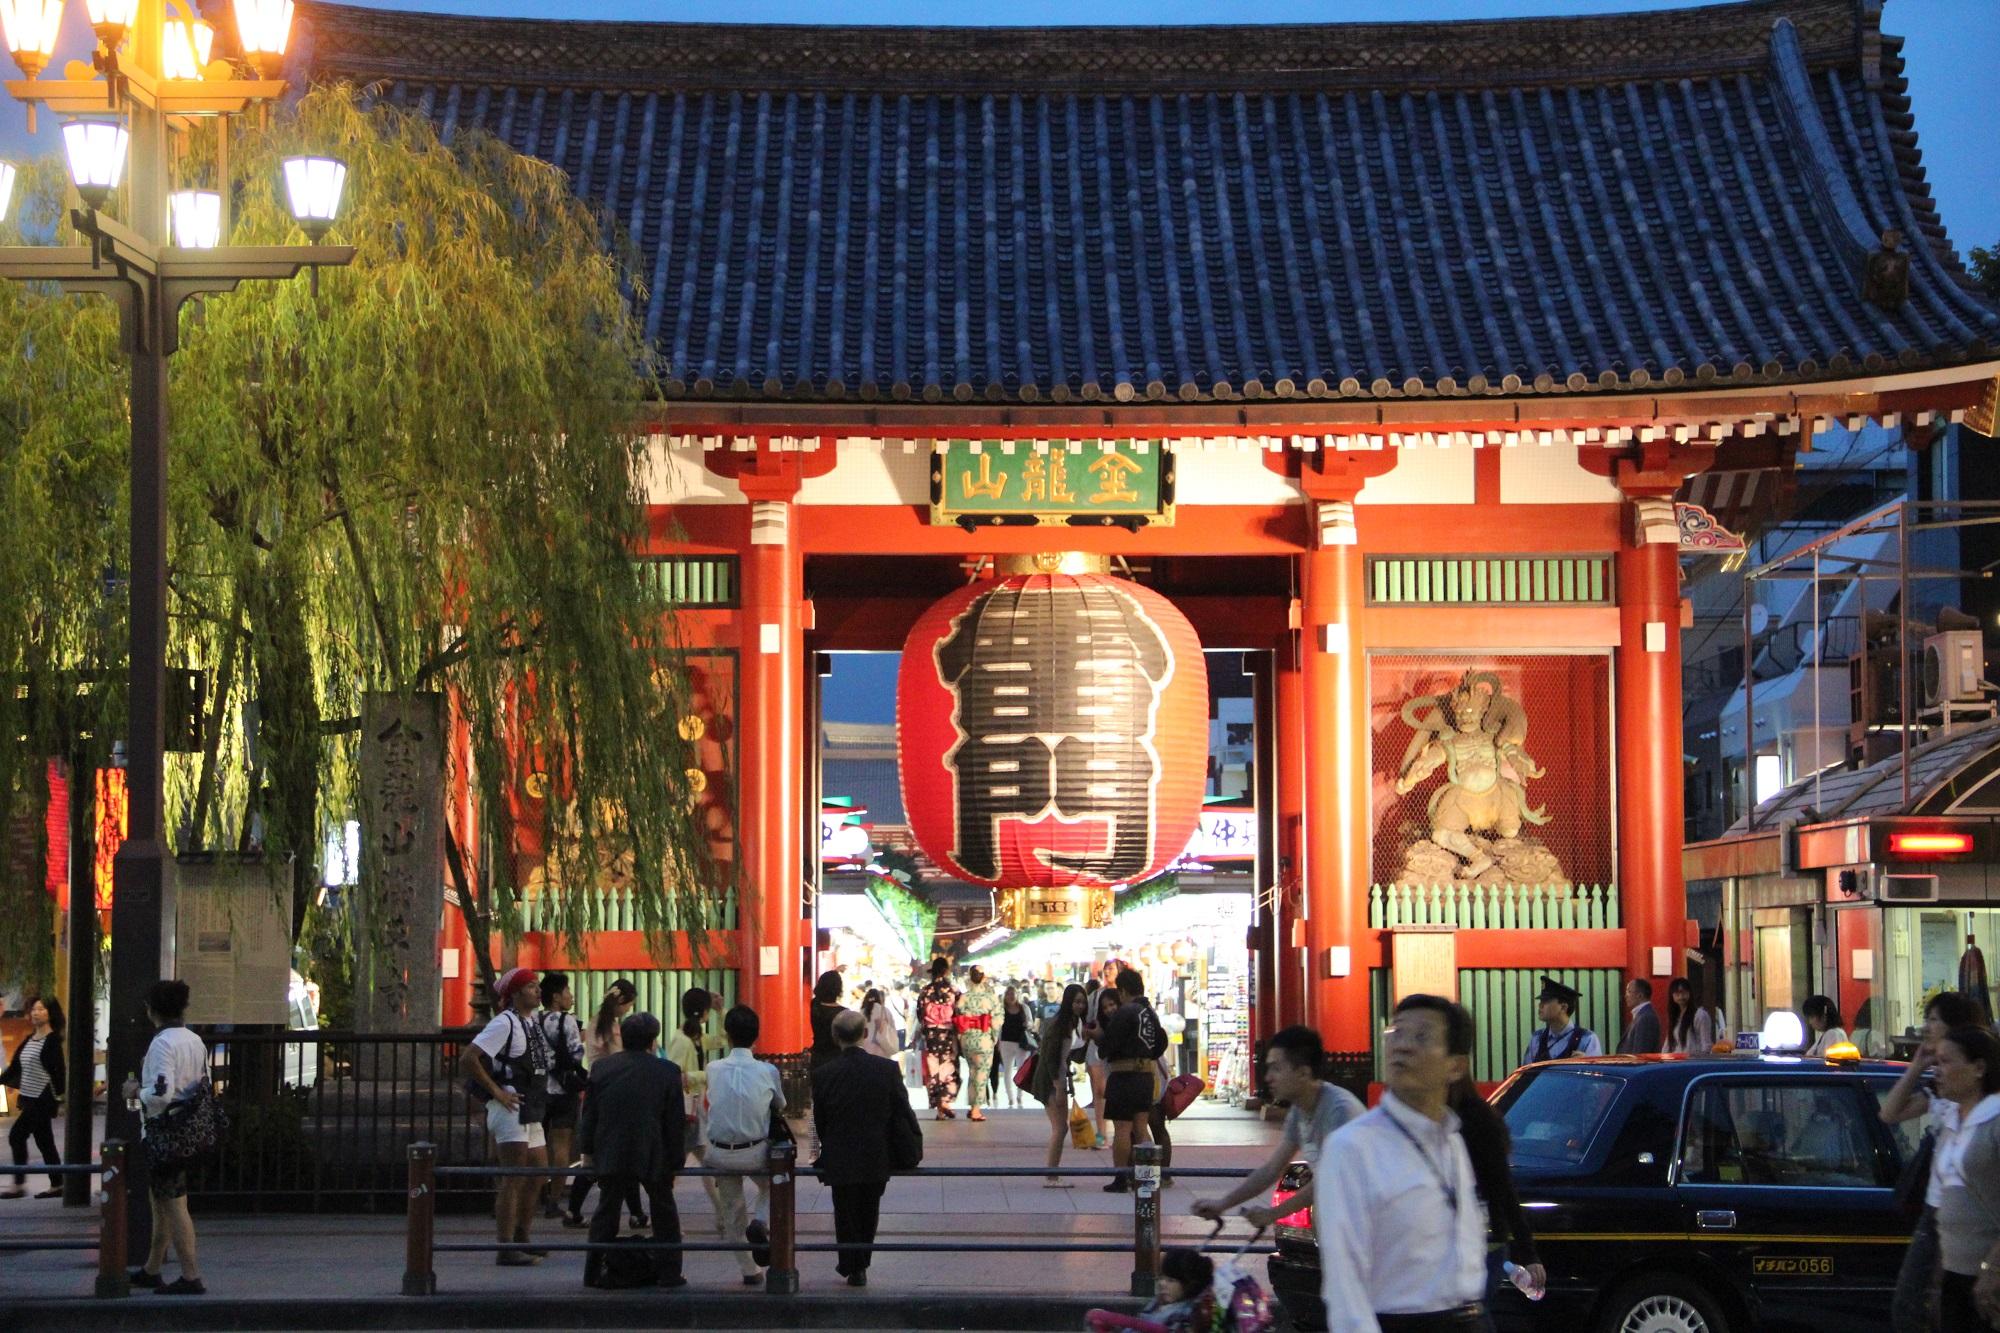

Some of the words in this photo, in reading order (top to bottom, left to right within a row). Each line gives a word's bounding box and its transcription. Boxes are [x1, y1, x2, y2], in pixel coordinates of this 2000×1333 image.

[962, 448, 1144, 504] 金龍山
[932, 585, 1176, 882] 雷門
[1799, 1259, 1831, 1273] 056
